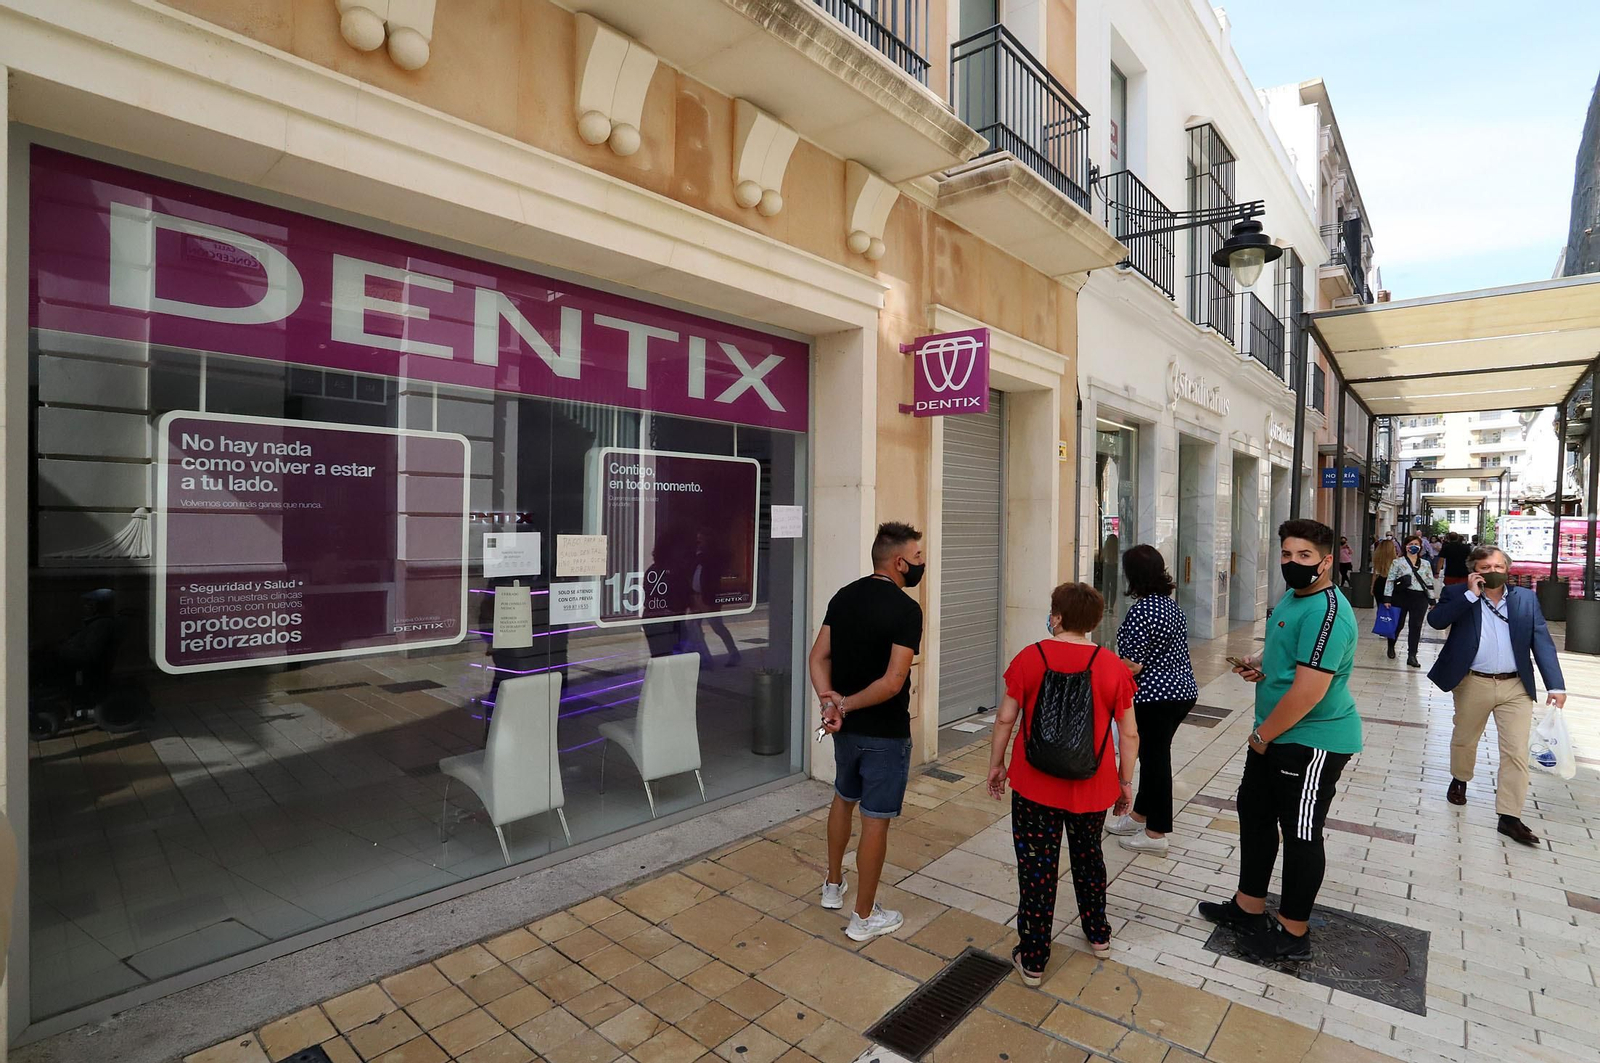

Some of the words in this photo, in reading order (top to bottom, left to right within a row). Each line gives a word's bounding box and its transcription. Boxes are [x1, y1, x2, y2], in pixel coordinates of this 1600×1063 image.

[109, 201, 787, 413] DENTIX
[916, 396, 981, 411] DENTIX
[182, 433, 214, 451] No
[220, 436, 258, 457] hay
[263, 441, 312, 457] nada
[181, 458, 246, 472] como
[250, 458, 310, 476] volver
[314, 464, 326, 476] a
[330, 463, 376, 478] estar
[610, 462, 655, 478] Contigo,
[181, 477, 194, 490] a
[201, 475, 222, 490] tu
[229, 475, 278, 492] lado.
[610, 480, 623, 489] en
[626, 479, 650, 490] todo
[654, 482, 702, 492] momento.
[190, 582, 252, 594] Seguridad
[254, 583, 261, 592] y
[264, 580, 295, 589] Salud
[180, 596, 193, 605] En
[197, 594, 225, 603] todas
[228, 593, 268, 602] nuestras
[271, 591, 303, 600] clínicas
[649, 597, 668, 609] dto.
[180, 605, 242, 615] atendemos
[268, 600, 302, 609] nuevos
[181, 611, 302, 637] protocolos
[393, 623, 443, 632] DENTIX
[181, 629, 302, 652] reforzados
